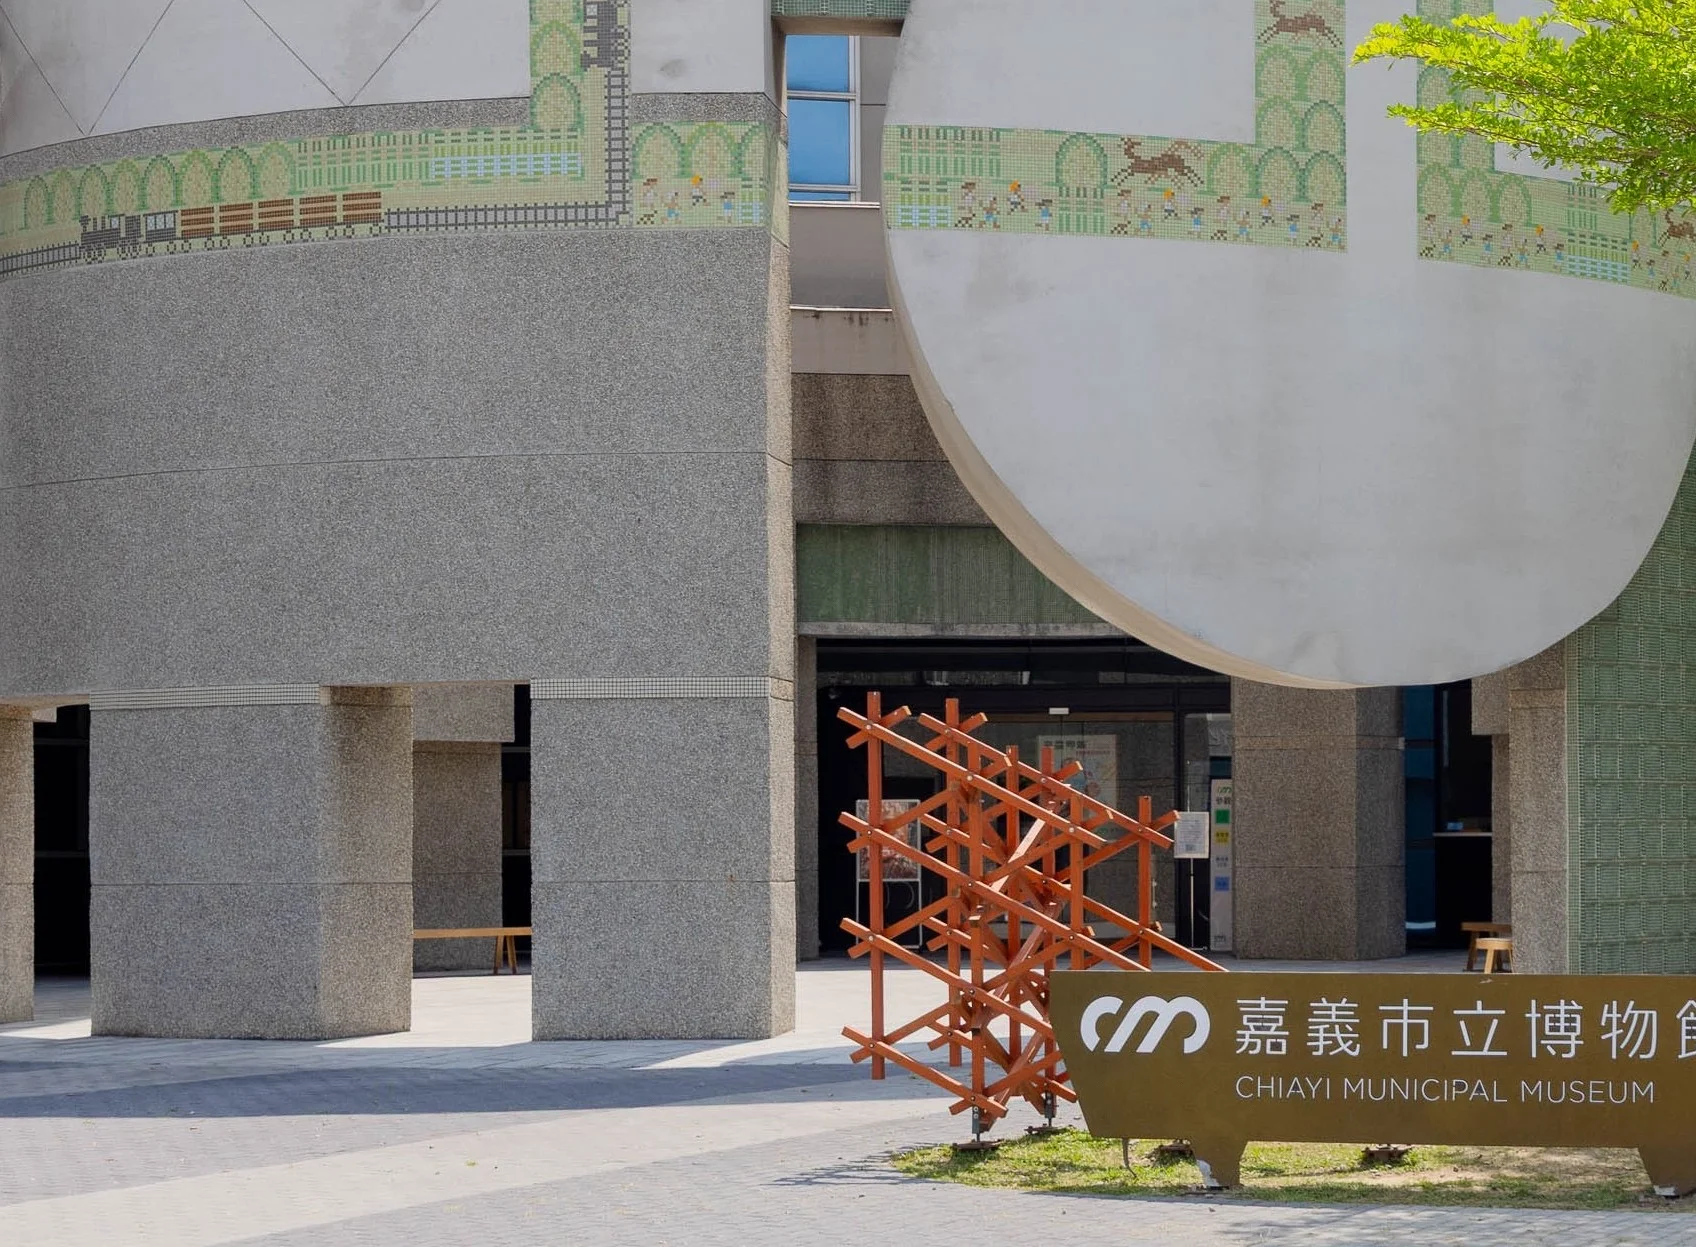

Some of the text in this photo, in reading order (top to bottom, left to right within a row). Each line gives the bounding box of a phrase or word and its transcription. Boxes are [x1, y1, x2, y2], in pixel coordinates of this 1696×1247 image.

[1235, 1076, 1655, 1104] CHIAYI MUNICIPAL MUSEUM
